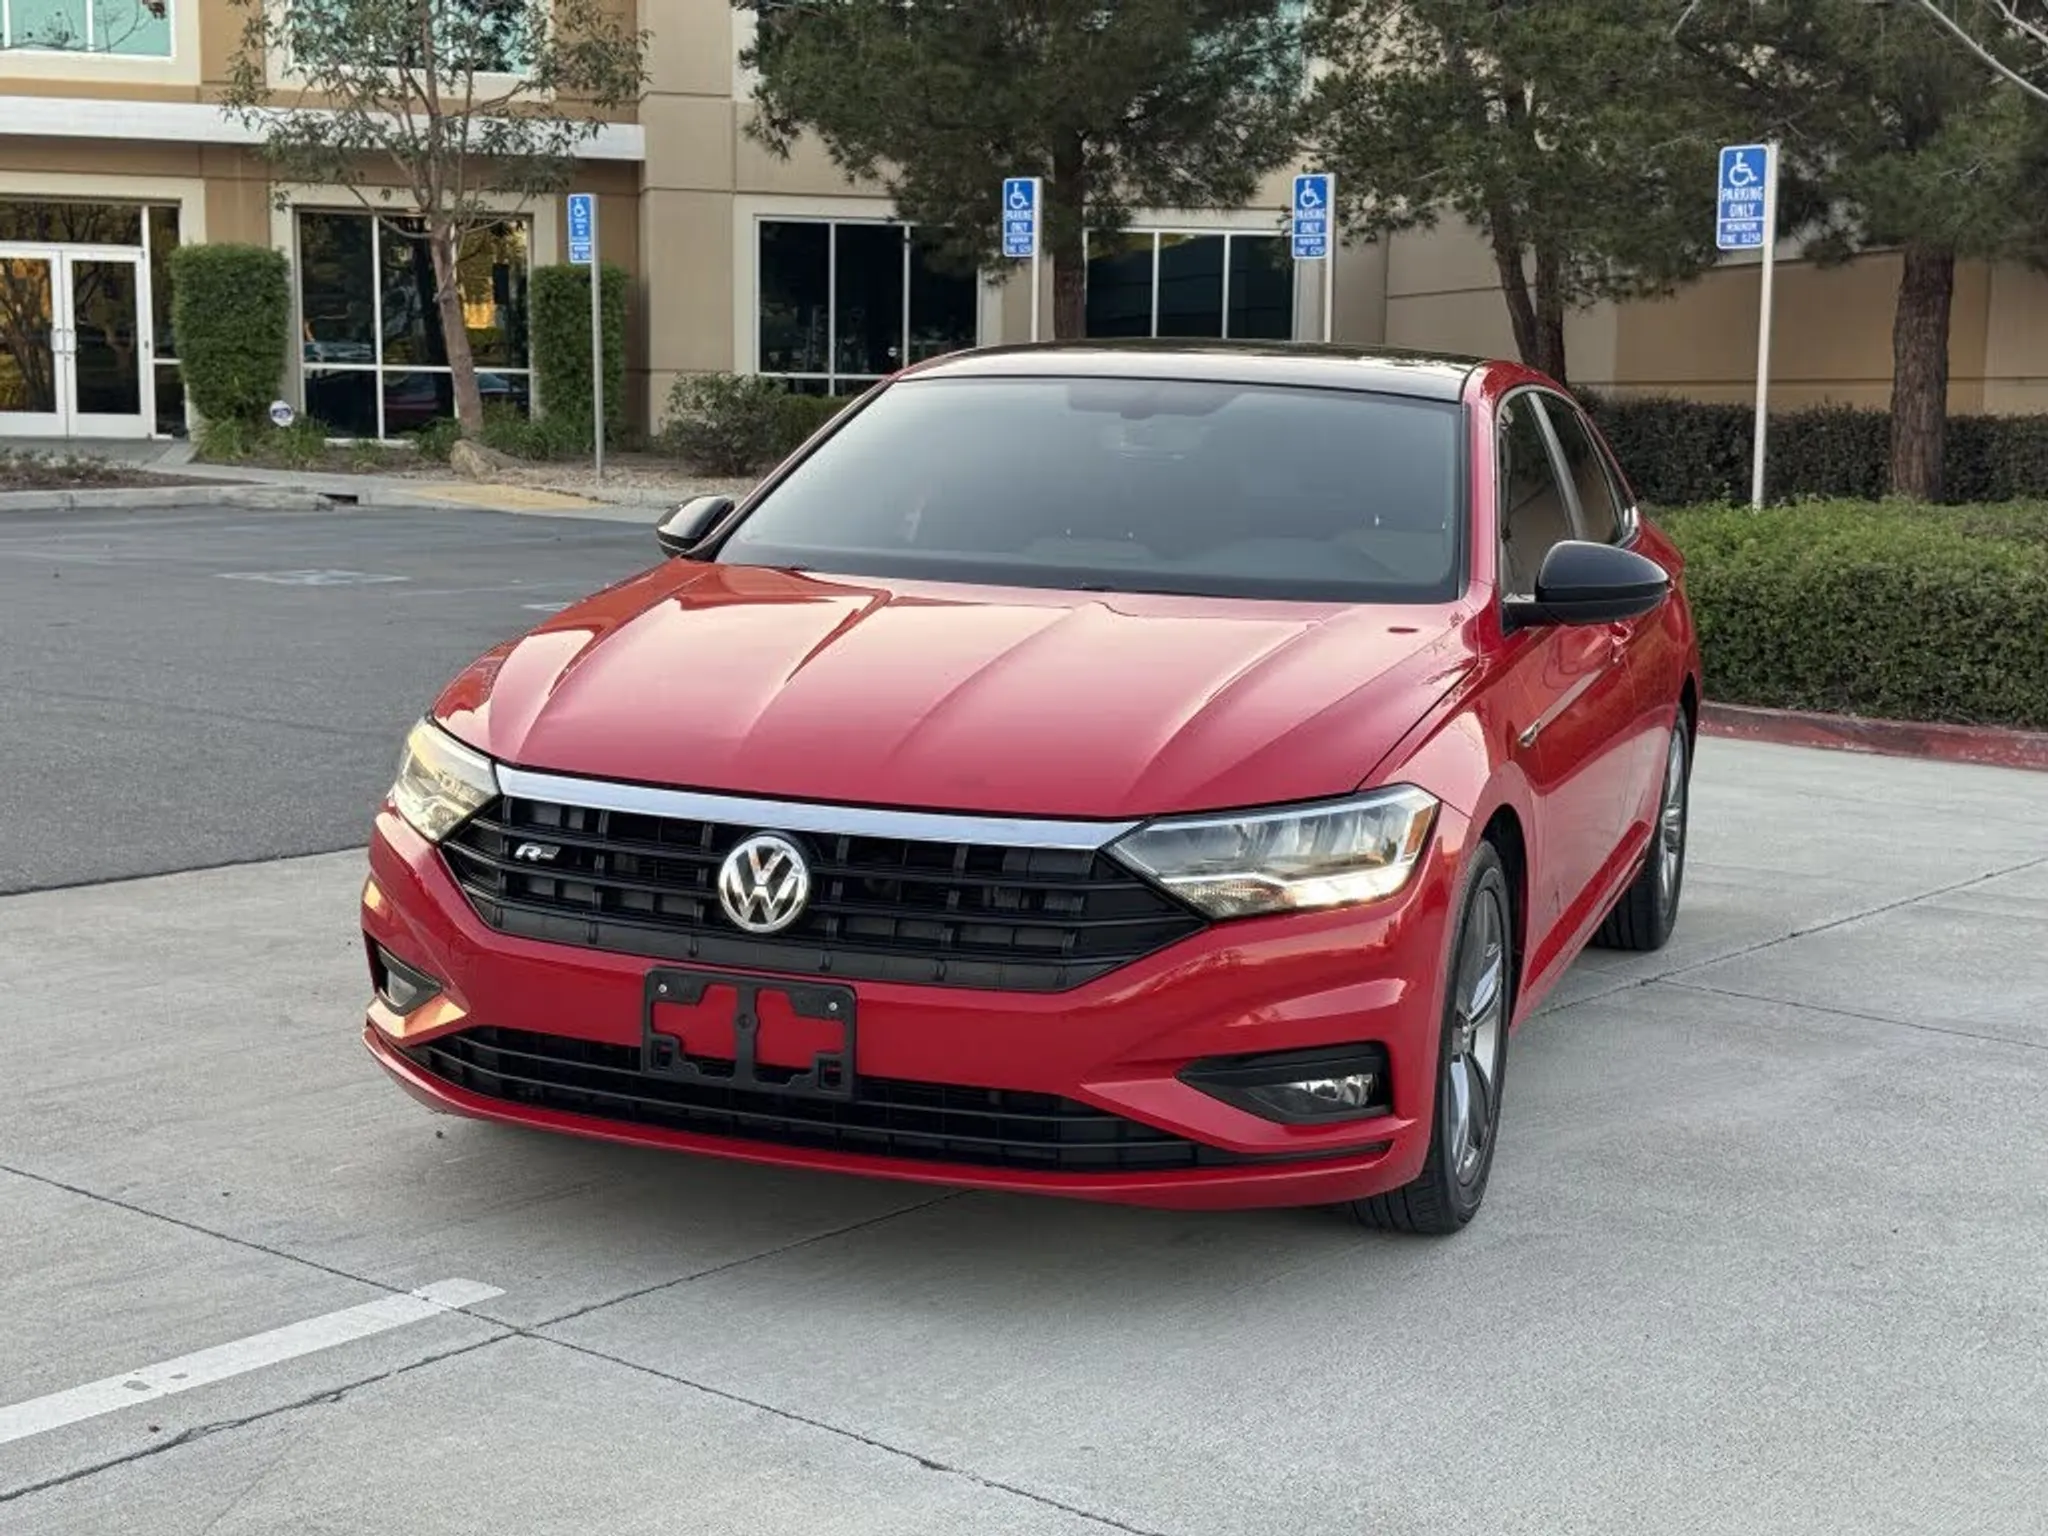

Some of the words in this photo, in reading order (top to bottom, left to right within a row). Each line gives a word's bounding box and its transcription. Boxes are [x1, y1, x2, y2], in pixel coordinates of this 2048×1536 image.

[1722, 186, 1764, 202] PARKING
[1729, 203, 1756, 217] ONLY
[1011, 222, 1028, 233] ONLY
[1301, 222, 1320, 233] ONLY
[722, 838, 804, 931] VW
